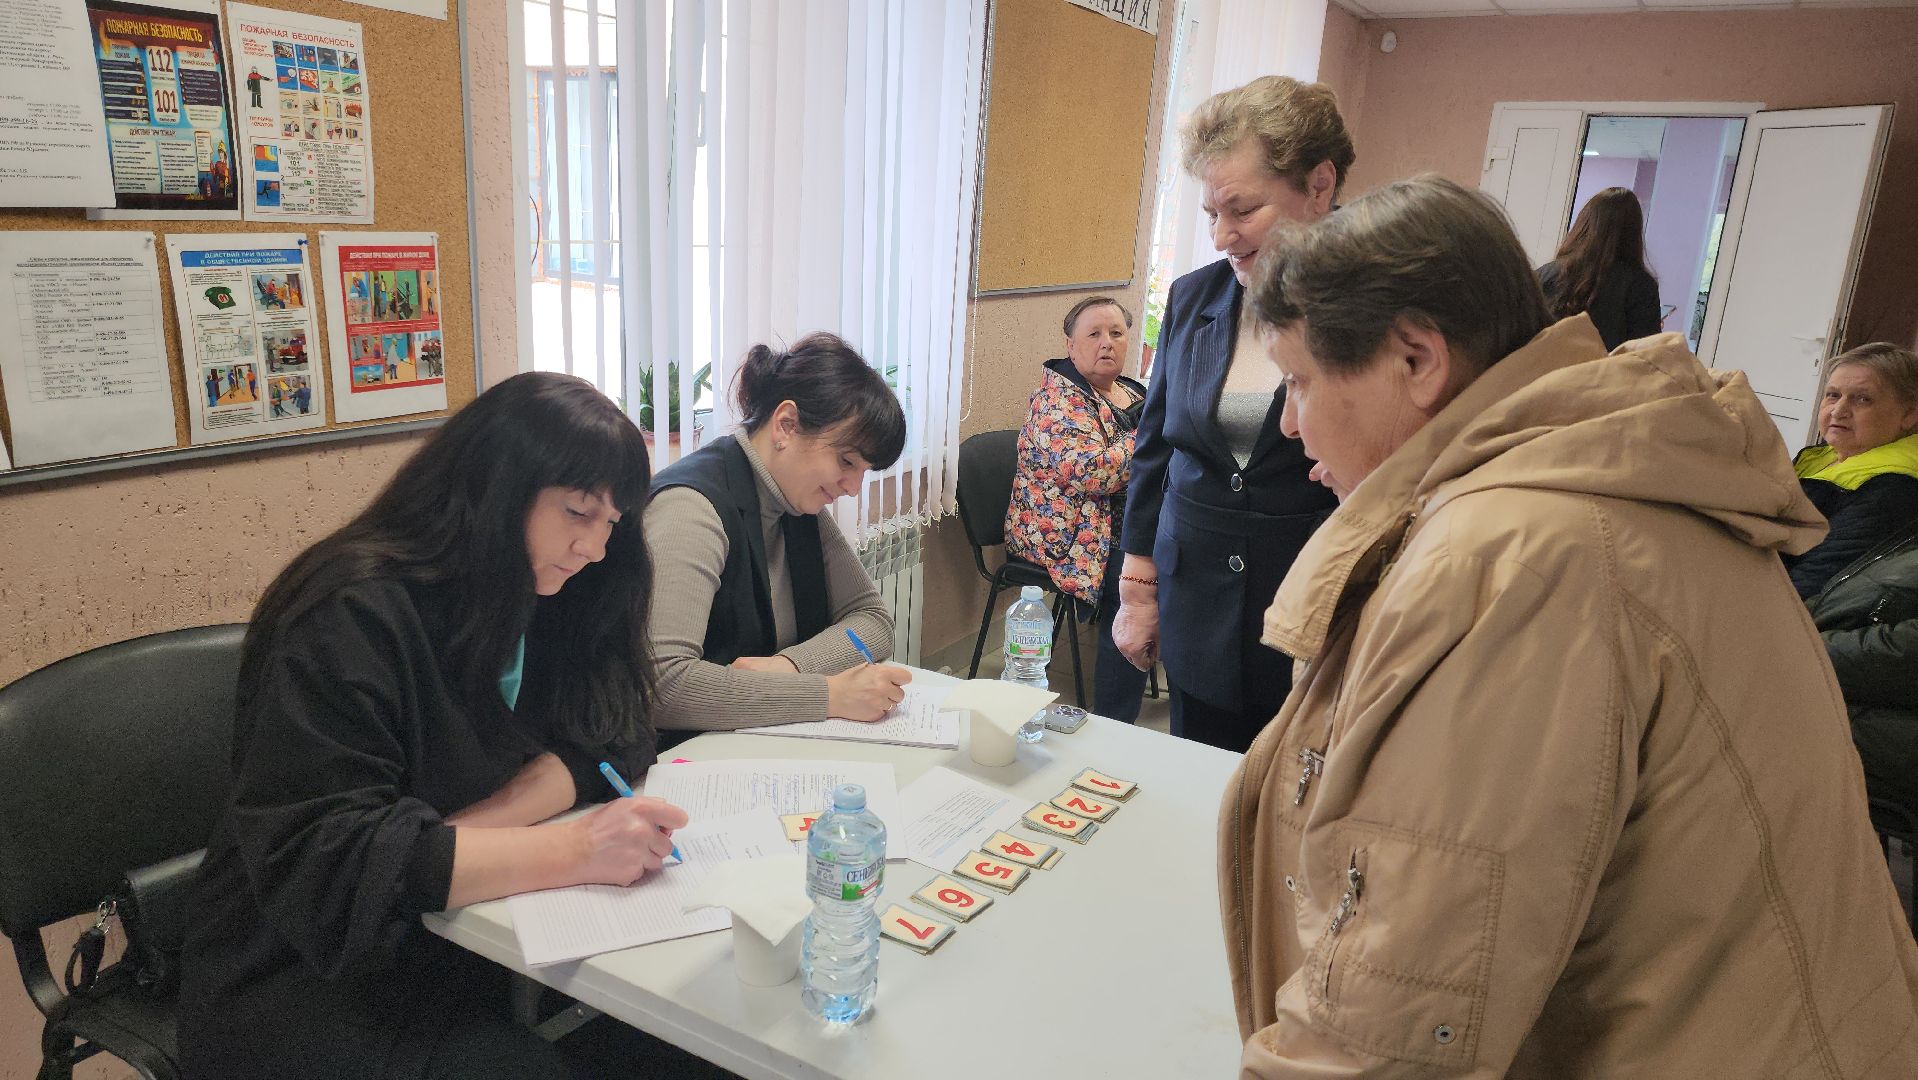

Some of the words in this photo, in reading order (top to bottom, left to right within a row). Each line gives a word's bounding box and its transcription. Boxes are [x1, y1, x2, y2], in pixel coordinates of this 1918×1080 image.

[106, 18, 149, 36] ПОЖАРНАЯ
[150, 22, 203, 42] БЕЗОПАСНОСТЬ
[240, 23, 288, 38] ПОЖАРНАЯ
[292, 32, 355, 48] БЕЗОПАСНОСТЬ
[148, 48, 174, 73] 112
[154, 89, 179, 114] 101
[1089, 778, 1121, 790] 1
[1066, 797, 1103, 814] 2
[1042, 813, 1077, 830] 3
[1000, 841, 1035, 857] 4
[974, 861, 1013, 880] 5
[937, 888, 975, 908] 6
[896, 917, 936, 941] 7
